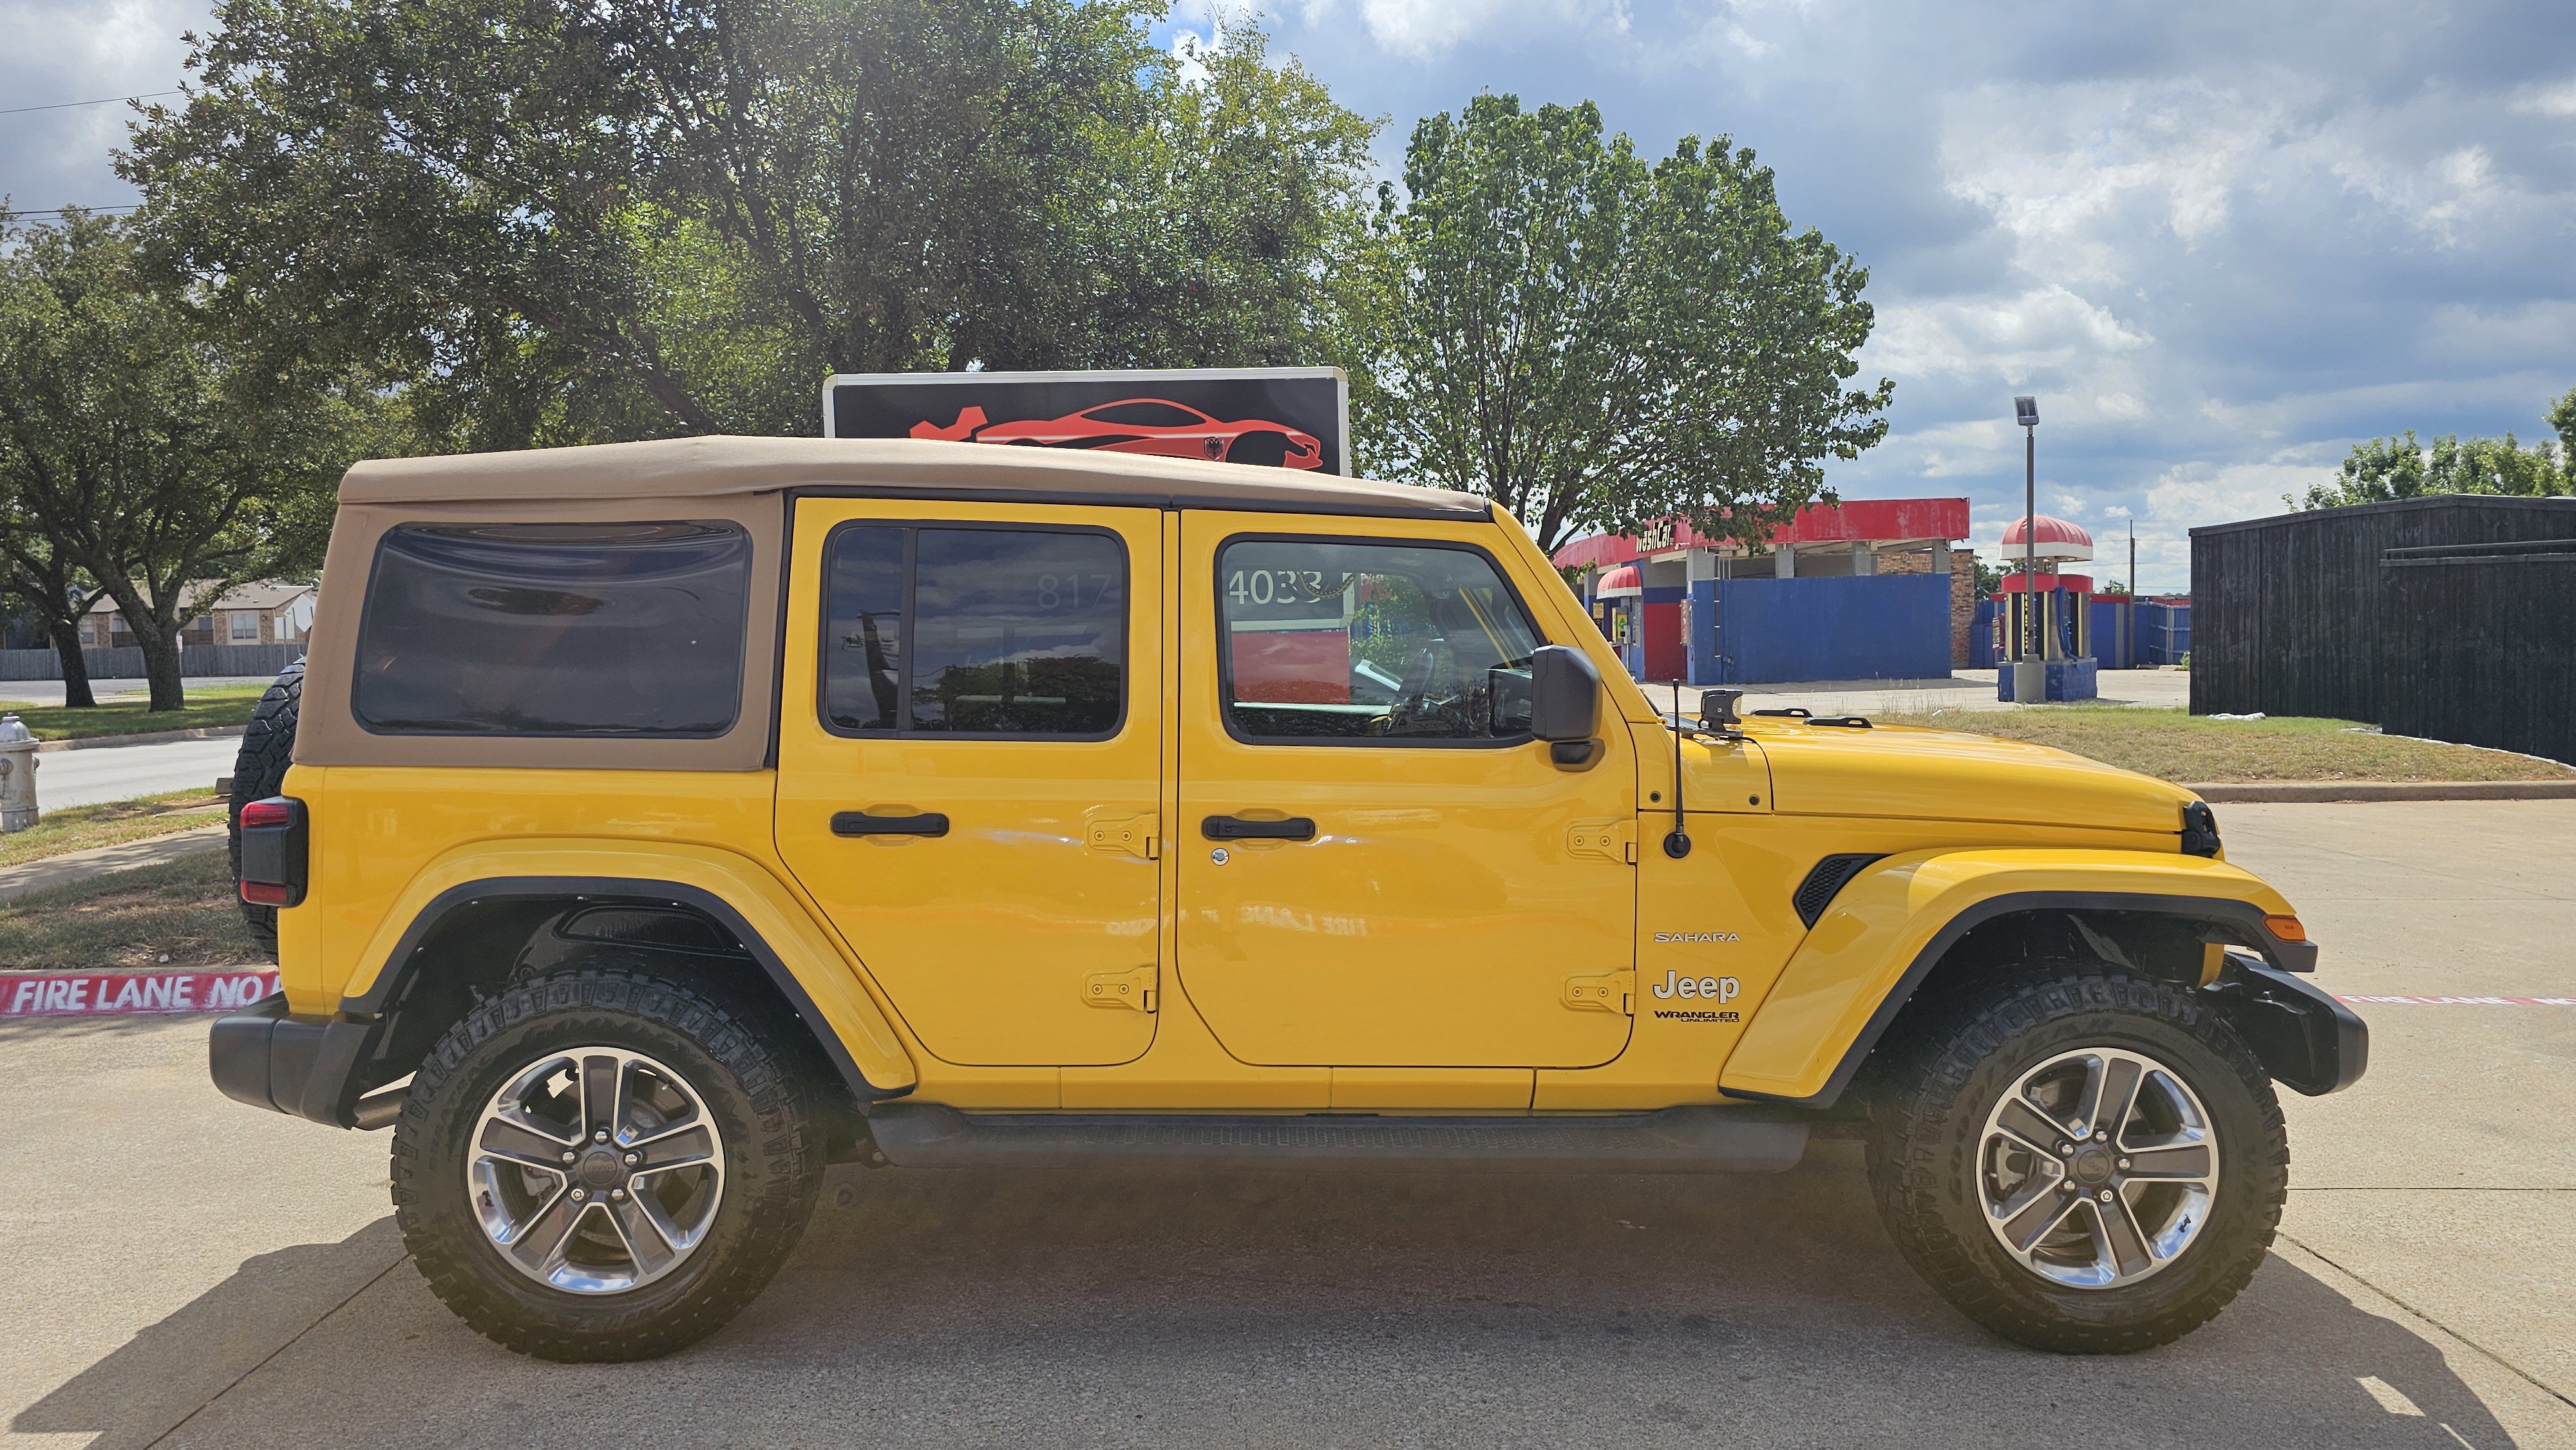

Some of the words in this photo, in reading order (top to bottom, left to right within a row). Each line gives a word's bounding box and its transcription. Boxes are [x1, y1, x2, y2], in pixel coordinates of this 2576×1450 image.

[1654, 932, 1740, 942] SAHARA
[12, 979, 90, 1013] FIRE
[96, 976, 195, 1010] LANE
[207, 976, 263, 1007] NO
[1653, 970, 1740, 1004] Jeep
